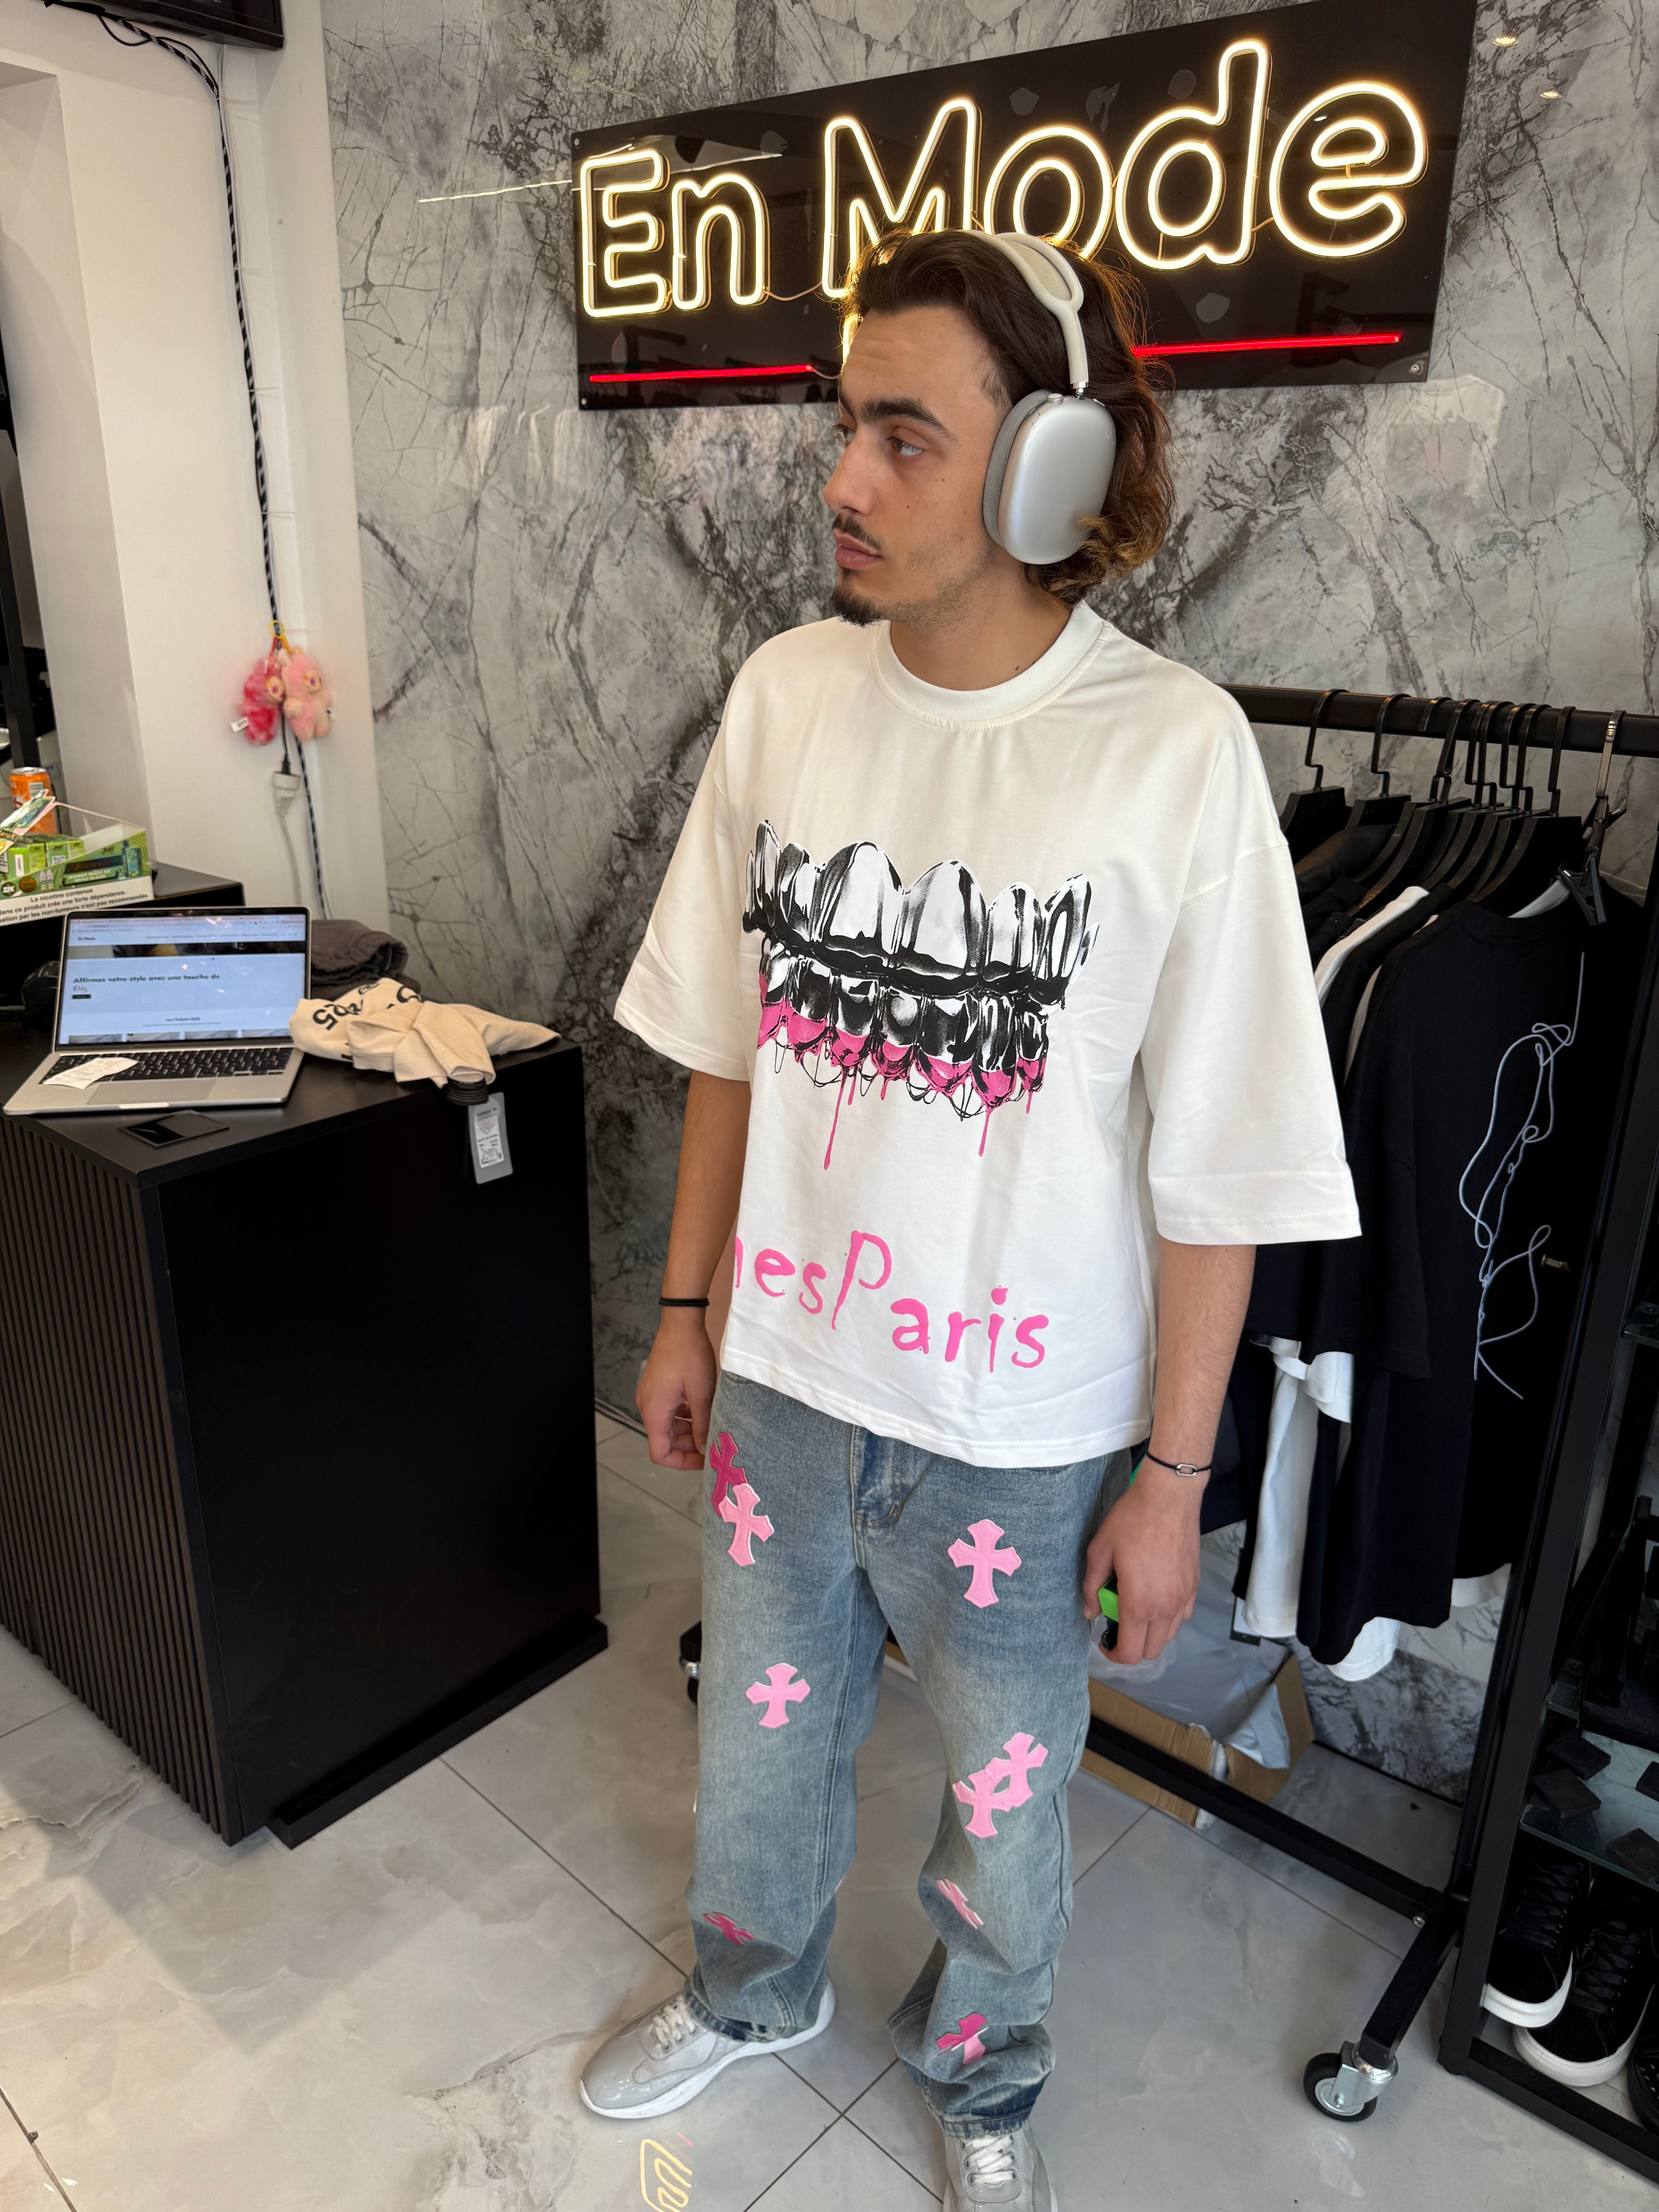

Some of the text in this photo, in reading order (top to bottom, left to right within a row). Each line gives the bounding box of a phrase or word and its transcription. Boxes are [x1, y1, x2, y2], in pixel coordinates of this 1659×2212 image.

[582, 39, 1426, 318] En Mode
[40, 891, 65, 900] nicotine
[24, 903, 46, 912] produit
